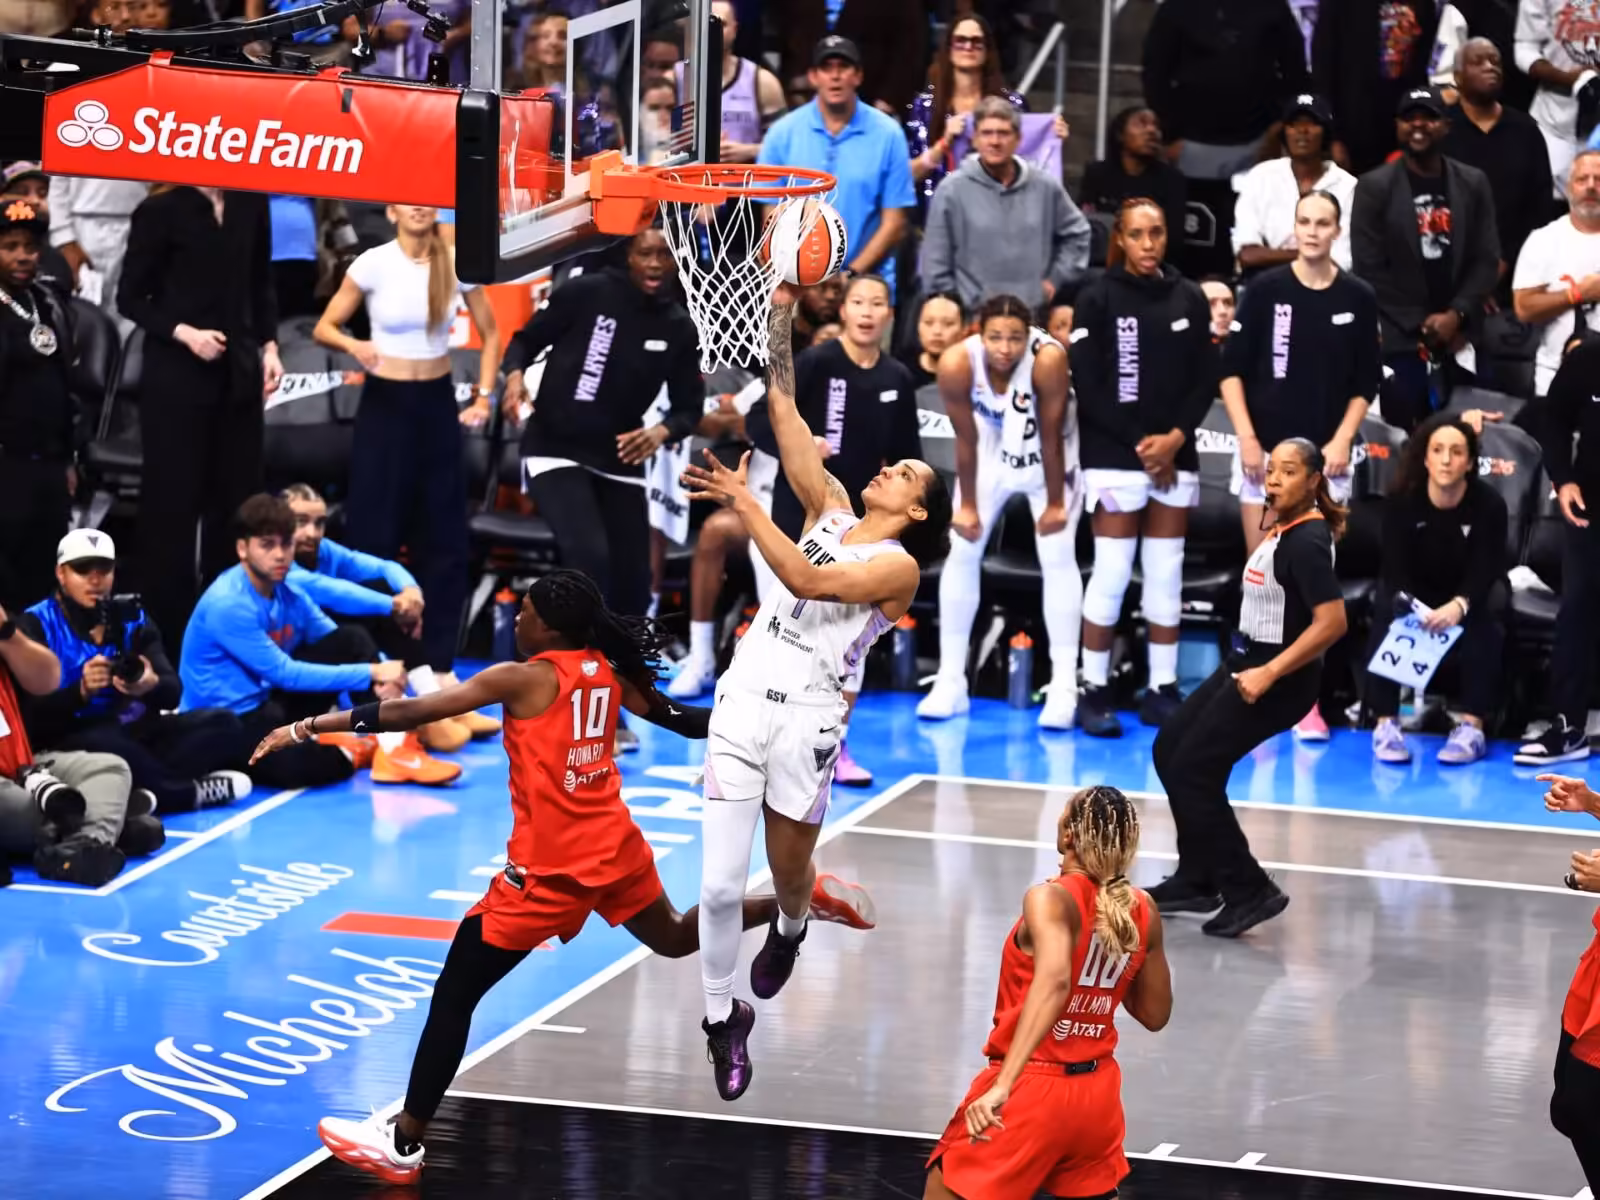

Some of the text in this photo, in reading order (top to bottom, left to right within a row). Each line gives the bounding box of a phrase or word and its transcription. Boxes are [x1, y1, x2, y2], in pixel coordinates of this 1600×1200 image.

[574, 314, 617, 401] VALKYRIES
[1117, 316, 1139, 403] VALKYRIES
[1272, 303, 1293, 379] VALKYRIES
[783, 627, 801, 640] KAISER
[1381, 651, 1401, 667] 2
[1412, 660, 1429, 676] 4
[570, 687, 611, 741] 10
[766, 688, 788, 703] GSV
[566, 742, 604, 767] HOWARD
[82, 862, 354, 967] Courtside
[1077, 932, 1131, 988] 00
[45, 948, 443, 1141] Michelob
[1069, 1021, 1106, 1038] AT&T
